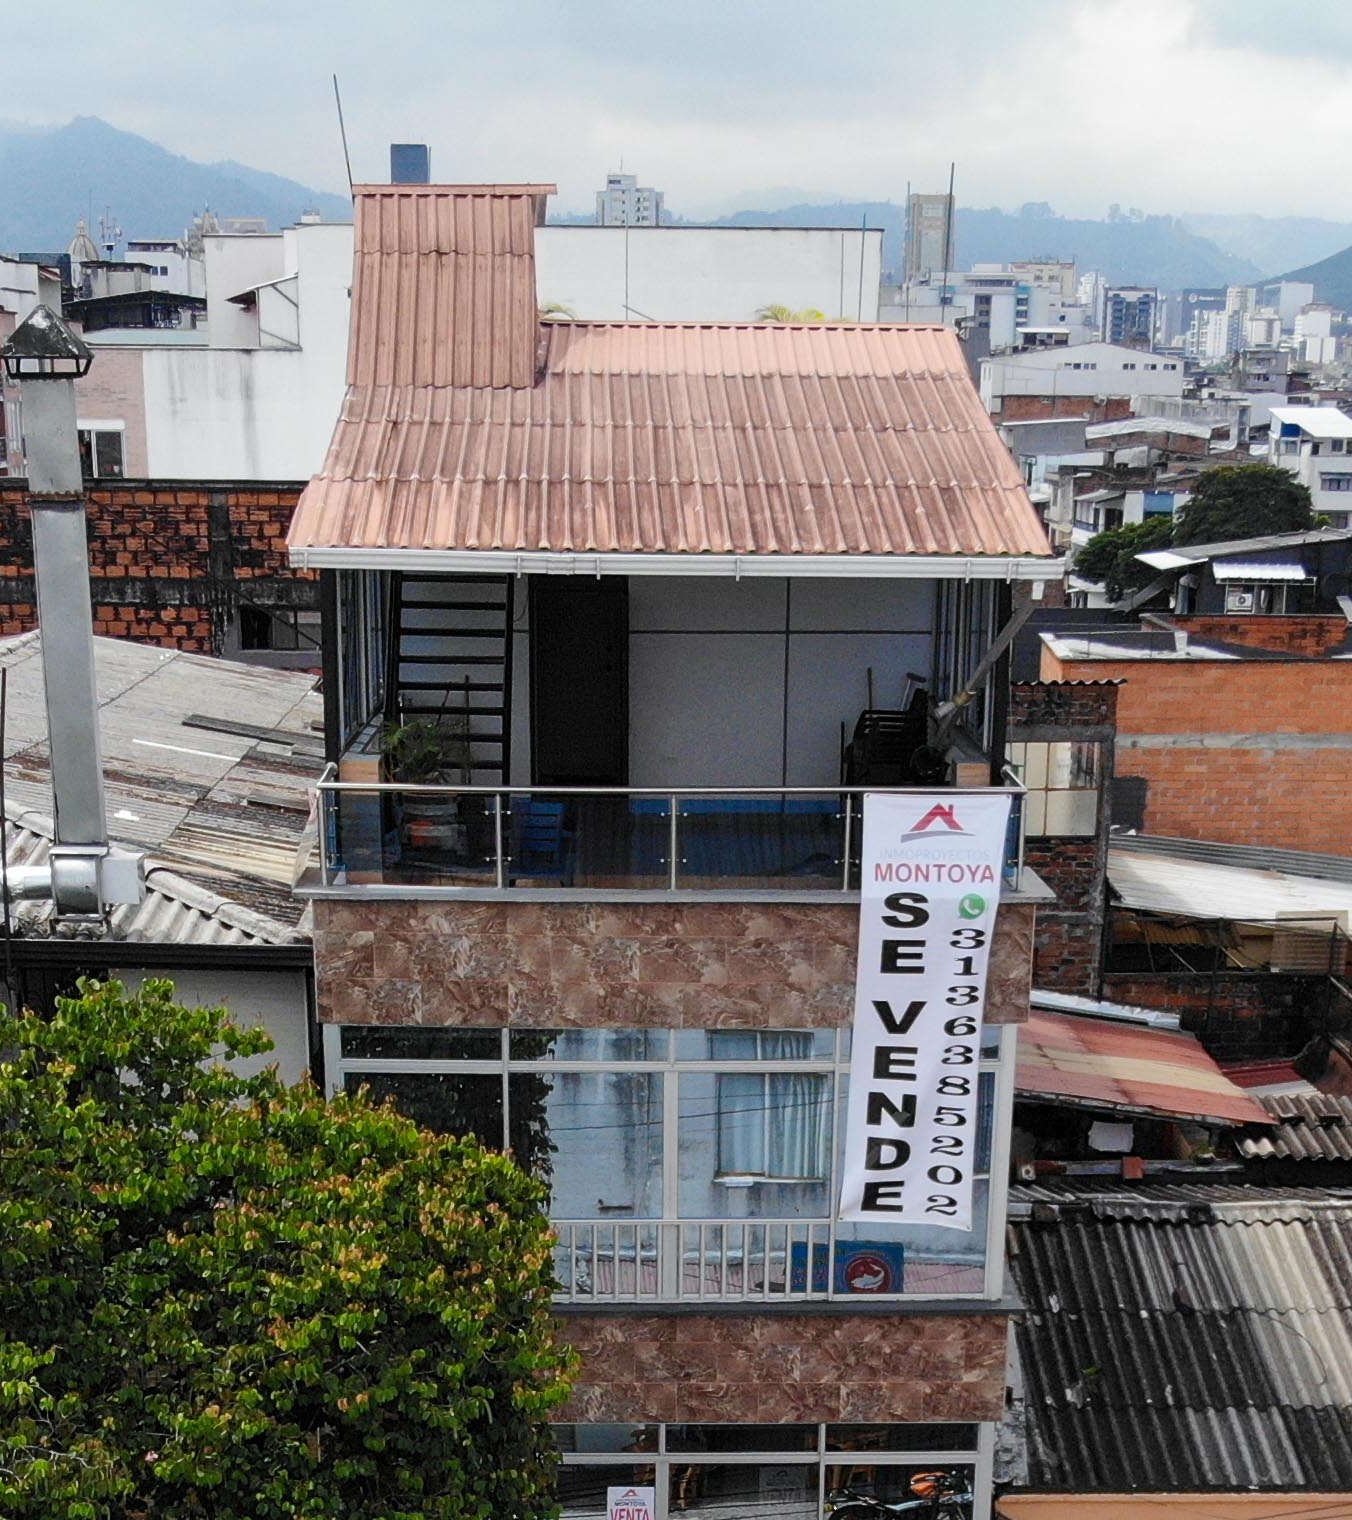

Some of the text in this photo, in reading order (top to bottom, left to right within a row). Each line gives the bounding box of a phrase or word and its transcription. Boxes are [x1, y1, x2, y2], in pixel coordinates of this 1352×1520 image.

[874, 863, 995, 884] MONTOYA
[879, 892, 930, 974] SE
[859, 1000, 928, 1214] VENDE
